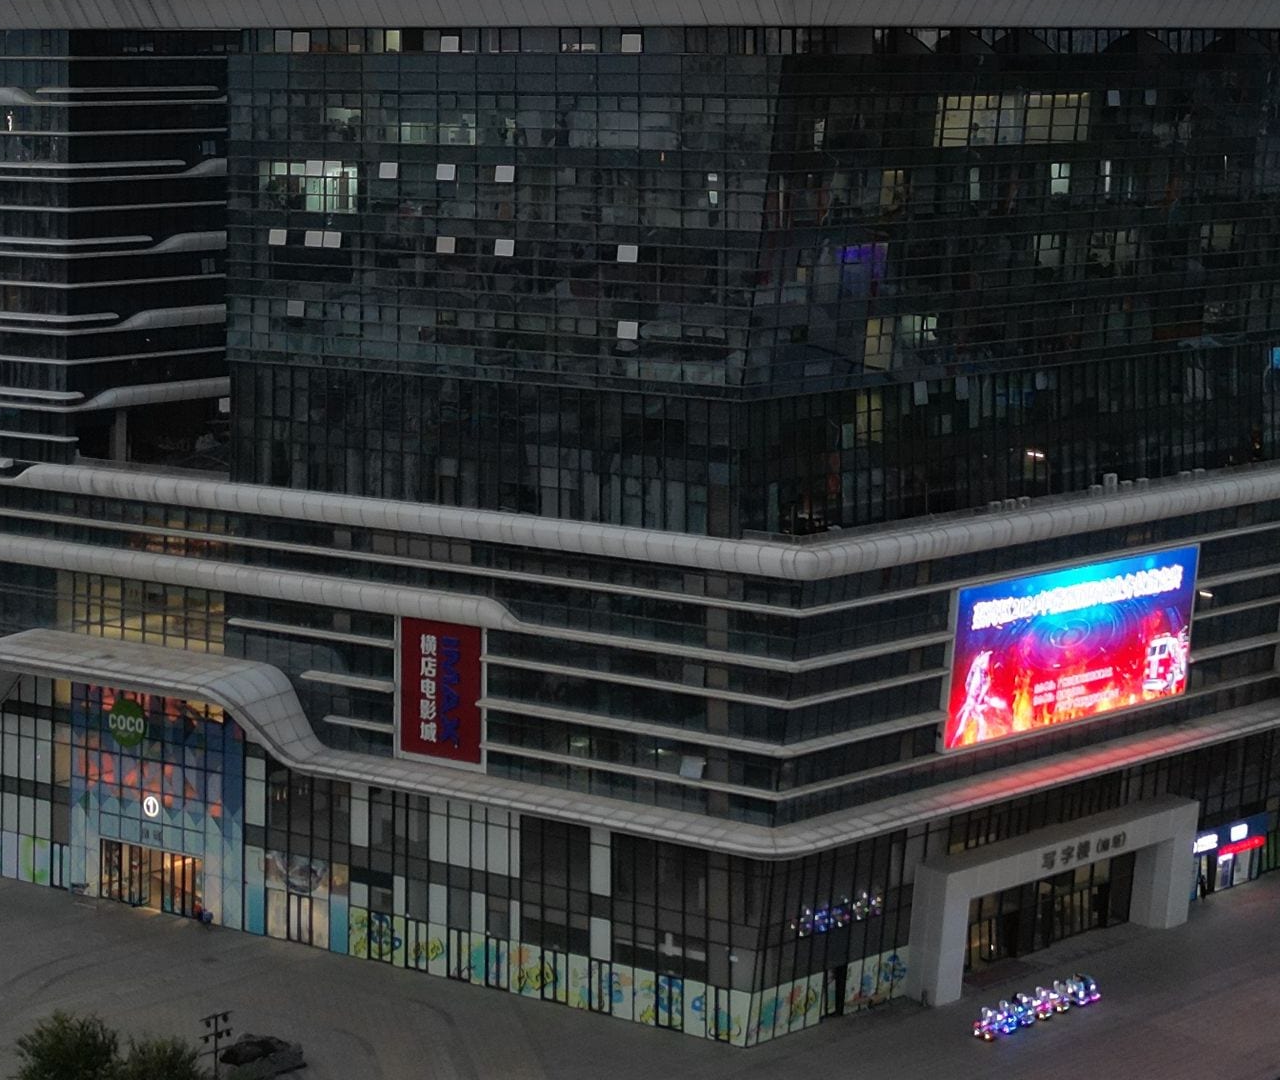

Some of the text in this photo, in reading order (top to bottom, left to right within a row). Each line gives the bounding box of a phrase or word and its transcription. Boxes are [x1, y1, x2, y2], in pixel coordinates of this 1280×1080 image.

[108, 713, 145, 735] COCO
[420, 633, 438, 745] 横店电影城
[440, 636, 461, 744] IMAX
